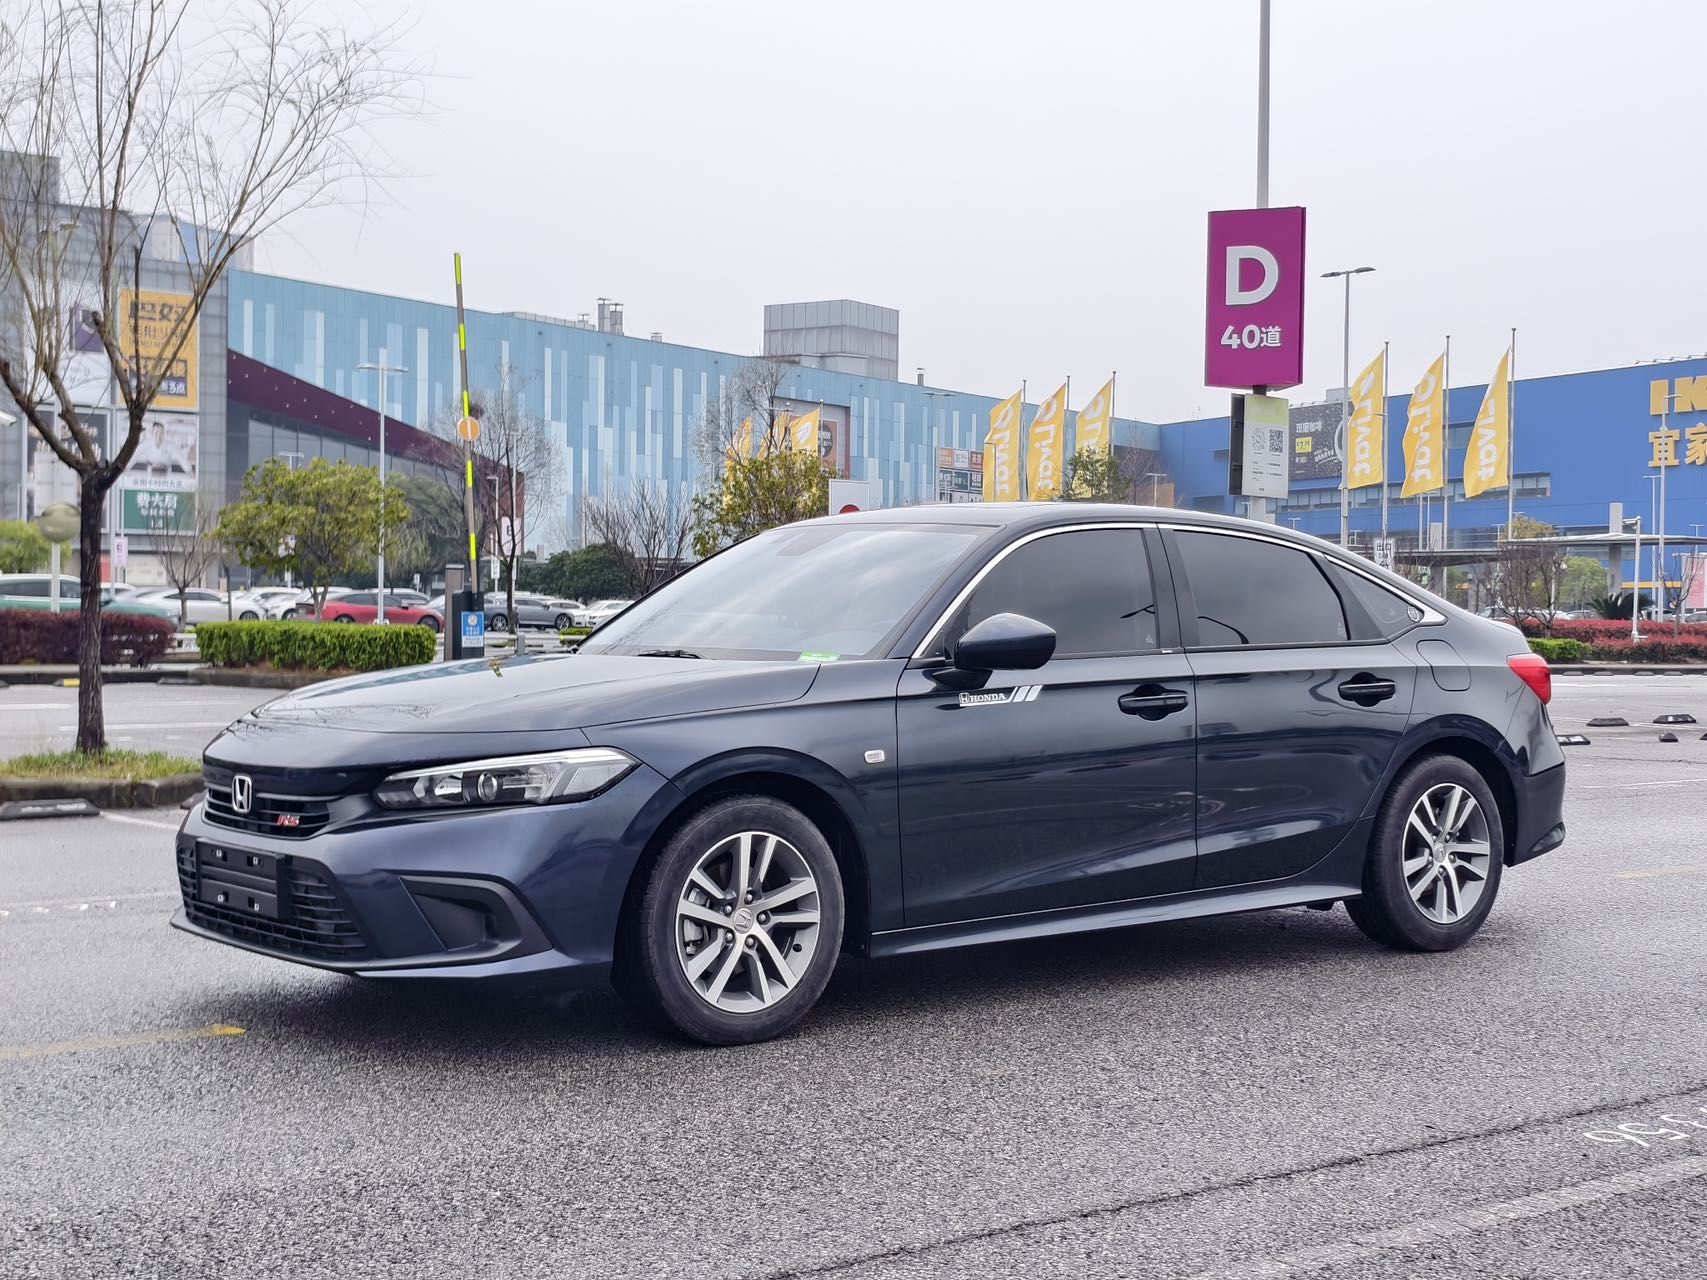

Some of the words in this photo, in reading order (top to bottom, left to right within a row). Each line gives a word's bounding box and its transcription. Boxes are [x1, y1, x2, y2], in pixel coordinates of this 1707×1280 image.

[1226, 245, 1279, 306] D
[1220, 324, 1282, 349] 40道
[969, 692, 1007, 702] HONDA
